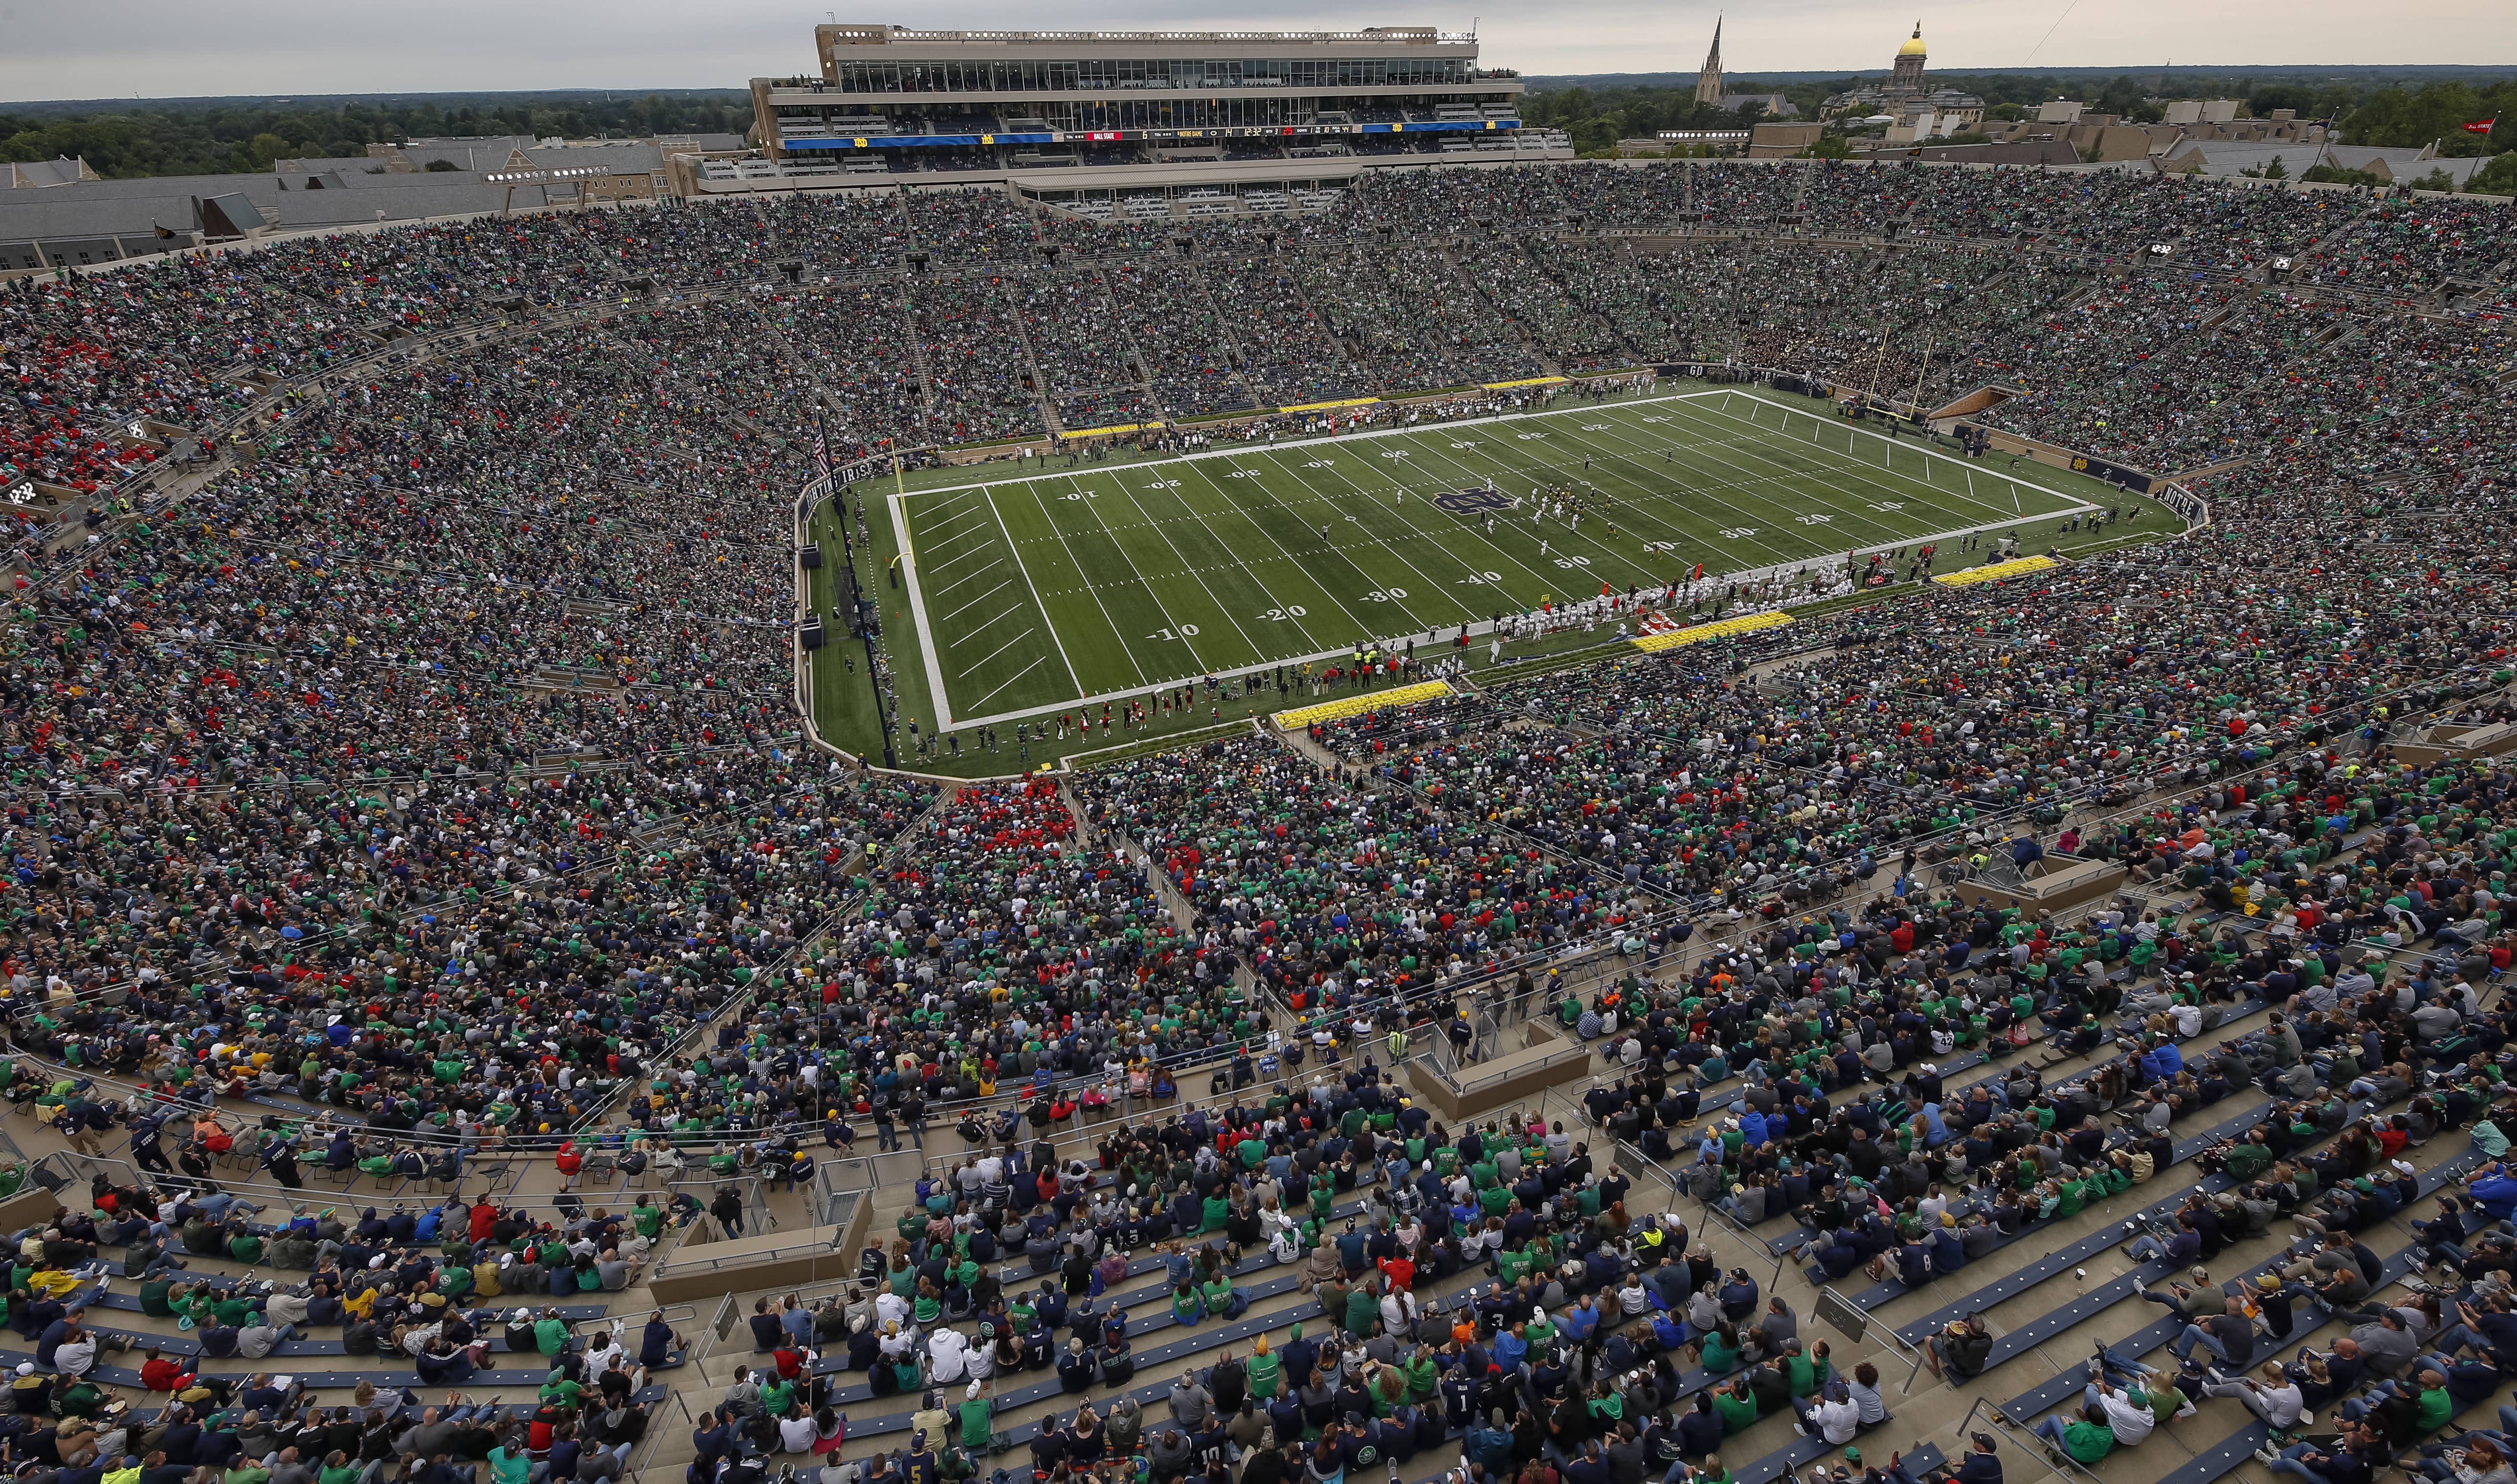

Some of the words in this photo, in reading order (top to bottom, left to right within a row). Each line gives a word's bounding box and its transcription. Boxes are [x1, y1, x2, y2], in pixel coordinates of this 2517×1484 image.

[1142, 131, 1147, 139] 6
[2152, 244, 2171, 254] 12:32
[2276, 258, 2289, 267] 25
[1690, 366, 1703, 376] GO
[131, 424, 143, 438] 25
[9, 482, 36, 505] 12:32
[1867, 501, 1901, 513] 10
[1795, 513, 1830, 526] 20
[1718, 527, 1756, 539] 30
[1643, 540, 1674, 553] 40
[1553, 555, 1591, 570] 50
[1467, 571, 1502, 585] 40
[1369, 587, 1408, 602] 30
[1267, 605, 1307, 621] 20
[1157, 623, 1200, 641] 10
[1666, 882, 1672, 891] 9
[1308, 928, 1314, 936] 5
[1496, 926, 1502, 935] 3
[1024, 1005, 1030, 1014] 5
[1625, 1010, 1630, 1019] 5
[1826, 1016, 1833, 1028] 3
[2193, 1014, 2202, 1022] 18
[1940, 1038, 1953, 1046] 42
[521, 1093, 528, 1102] 7
[1276, 1106, 1285, 1118] 7
[705, 1125, 713, 1136] 5
[141, 1132, 154, 1144] EVENT
[271, 1147, 286, 1159] EVENT
[797, 1163, 812, 1174] USHER
[1010, 1160, 1018, 1174] 1
[956, 1238, 962, 1251] 8
[1130, 1234, 1139, 1243] 3
[1283, 1241, 1295, 1253] 14
[1923, 1254, 1931, 1271] 8
[1491, 1314, 1504, 1327] 3
[1035, 1346, 1043, 1360] 7
[1459, 1394, 1467, 1412] 1
[1202, 1446, 1220, 1465] 10
[911, 1464, 921, 1484] 5
